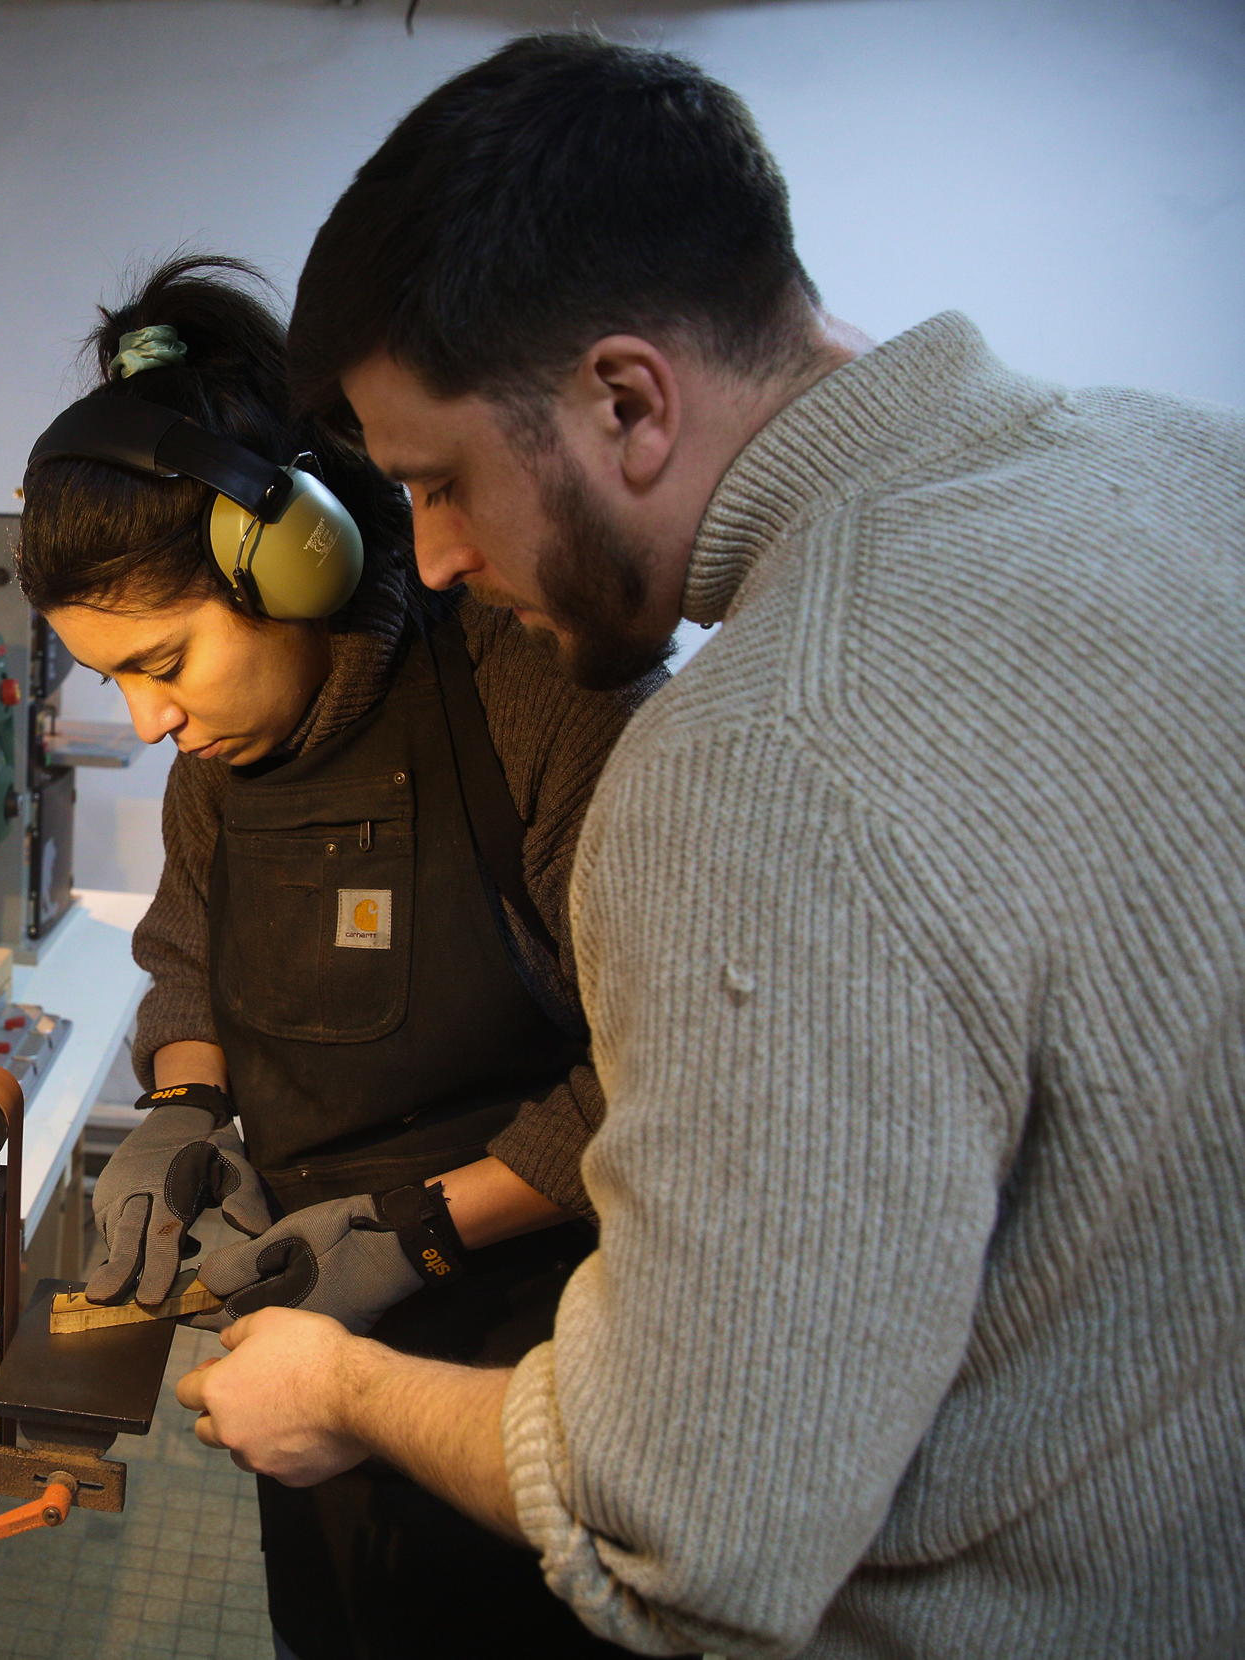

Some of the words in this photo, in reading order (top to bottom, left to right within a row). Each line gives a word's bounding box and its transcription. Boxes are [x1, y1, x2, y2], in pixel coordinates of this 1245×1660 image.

[345, 931, 378, 939] carhartt
[150, 1087, 188, 1100] site
[422, 1248, 451, 1275] site
